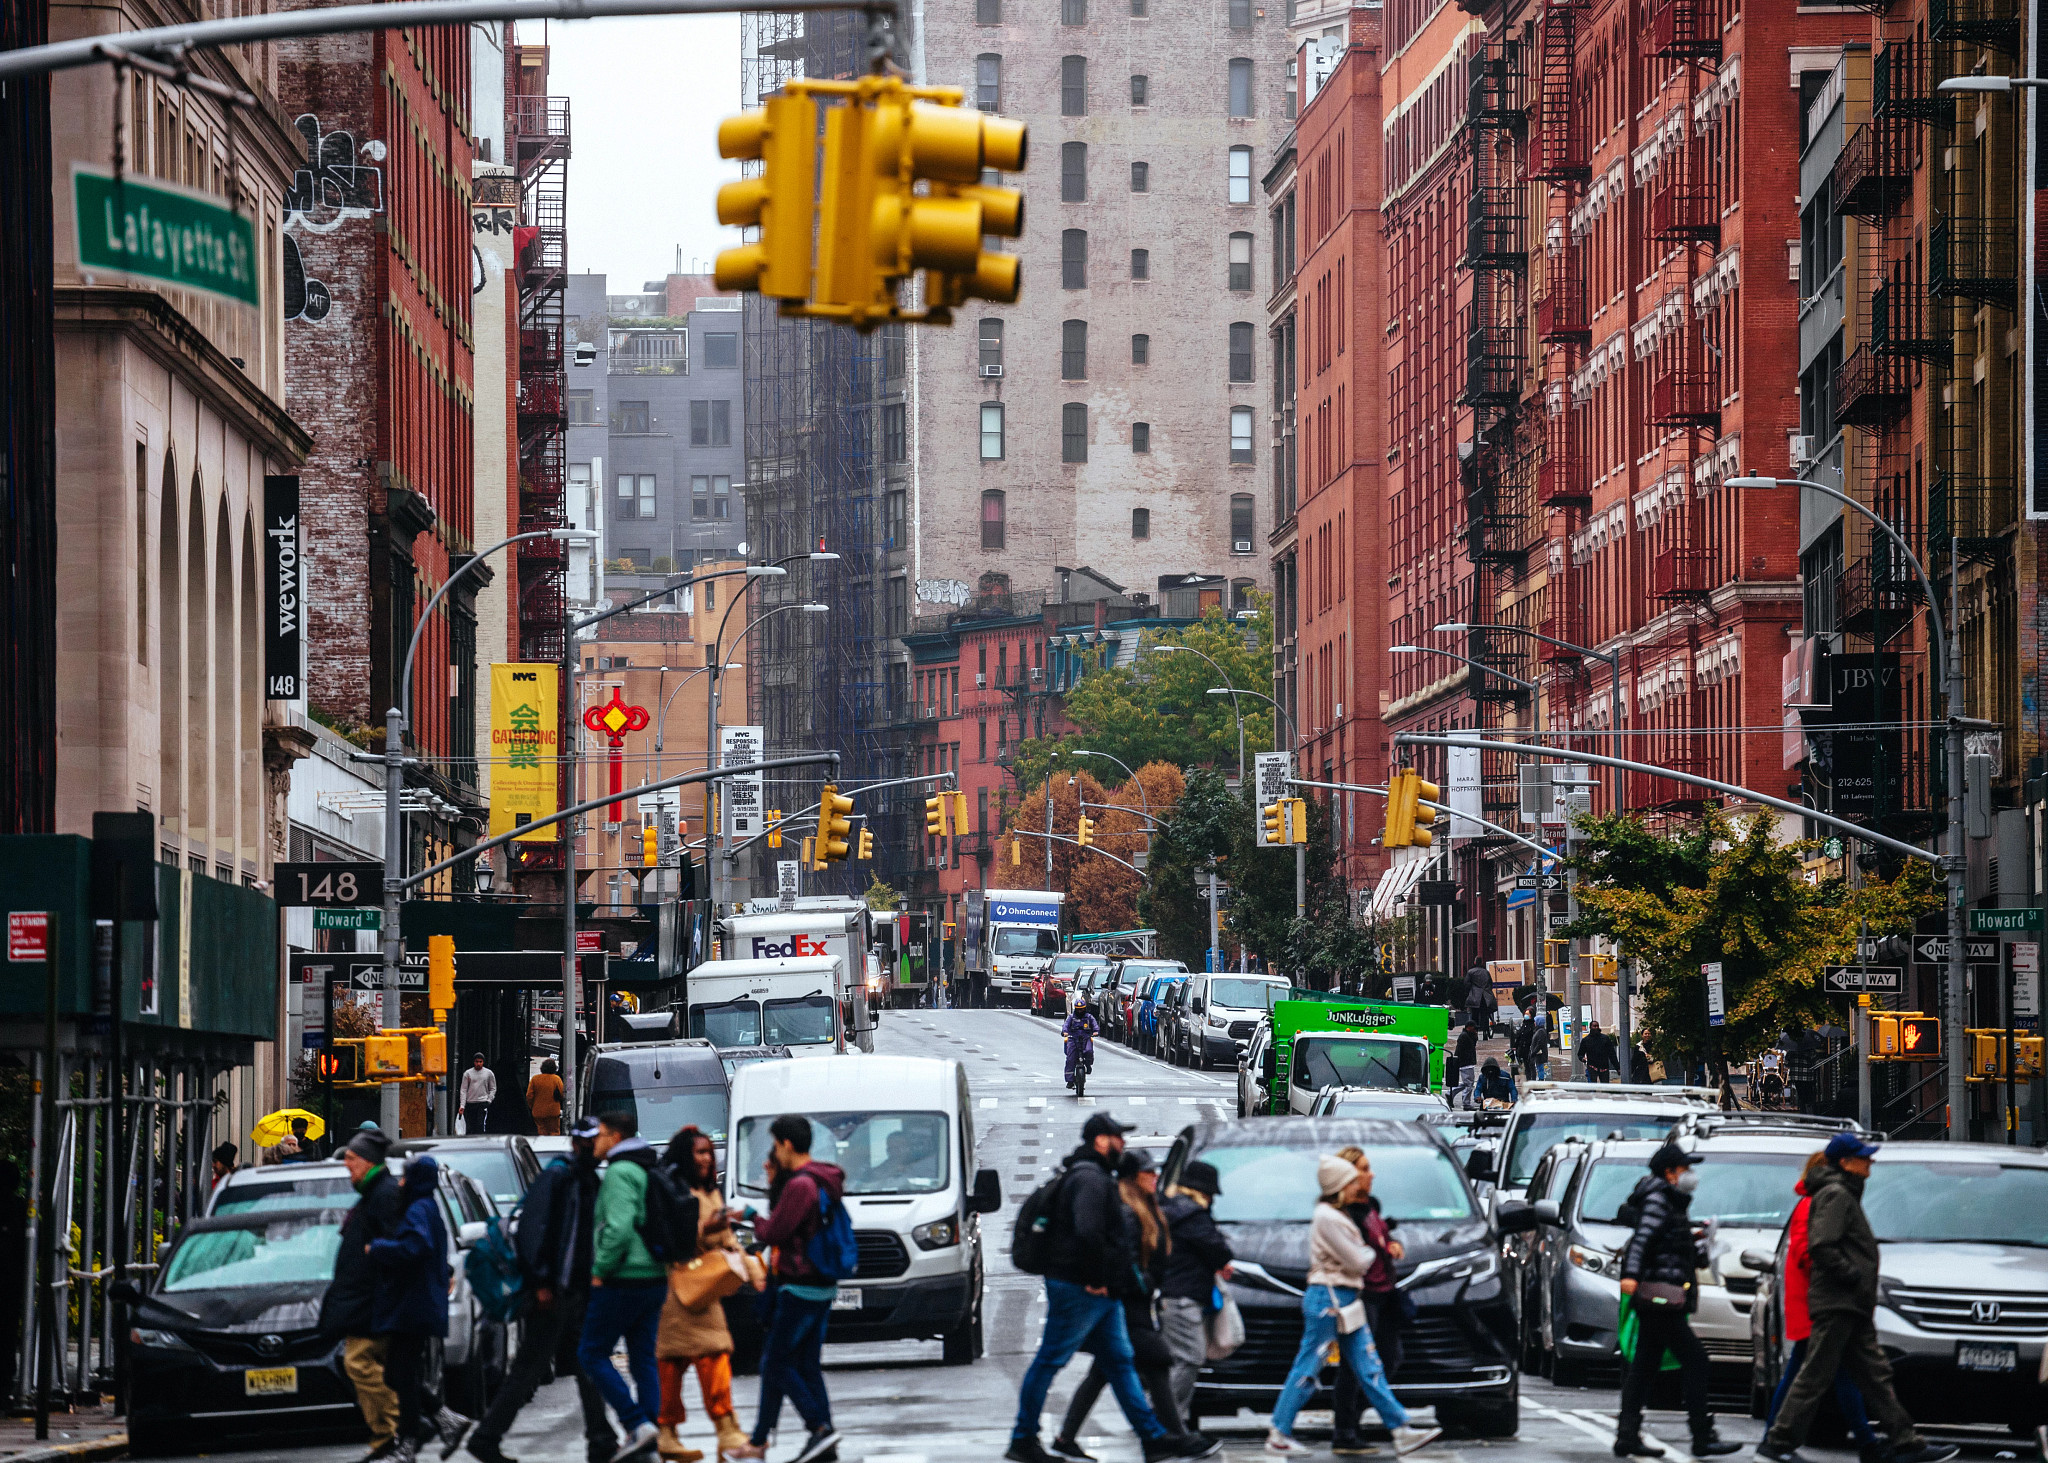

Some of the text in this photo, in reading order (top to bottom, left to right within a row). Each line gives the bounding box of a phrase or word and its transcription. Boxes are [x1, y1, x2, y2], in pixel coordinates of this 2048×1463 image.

[104, 196, 249, 284] Lafayette St
[268, 514, 296, 637] wework
[270, 675, 294, 695] 148
[512, 673, 537, 681] NYC
[1838, 667, 1895, 694] JBW
[492, 729, 556, 744] GATHERING
[1544, 829, 1566, 838] Grand
[297, 872, 359, 902] 148
[320, 911, 374, 927] Howard St
[1008, 907, 1057, 917] OhmConnect
[1977, 911, 2037, 928] Howard St
[752, 933, 828, 959] FedEx
[1927, 944, 1950, 955] ONE
[363, 972, 384, 983] ONE
[1836, 974, 1892, 985] ONE WAY
